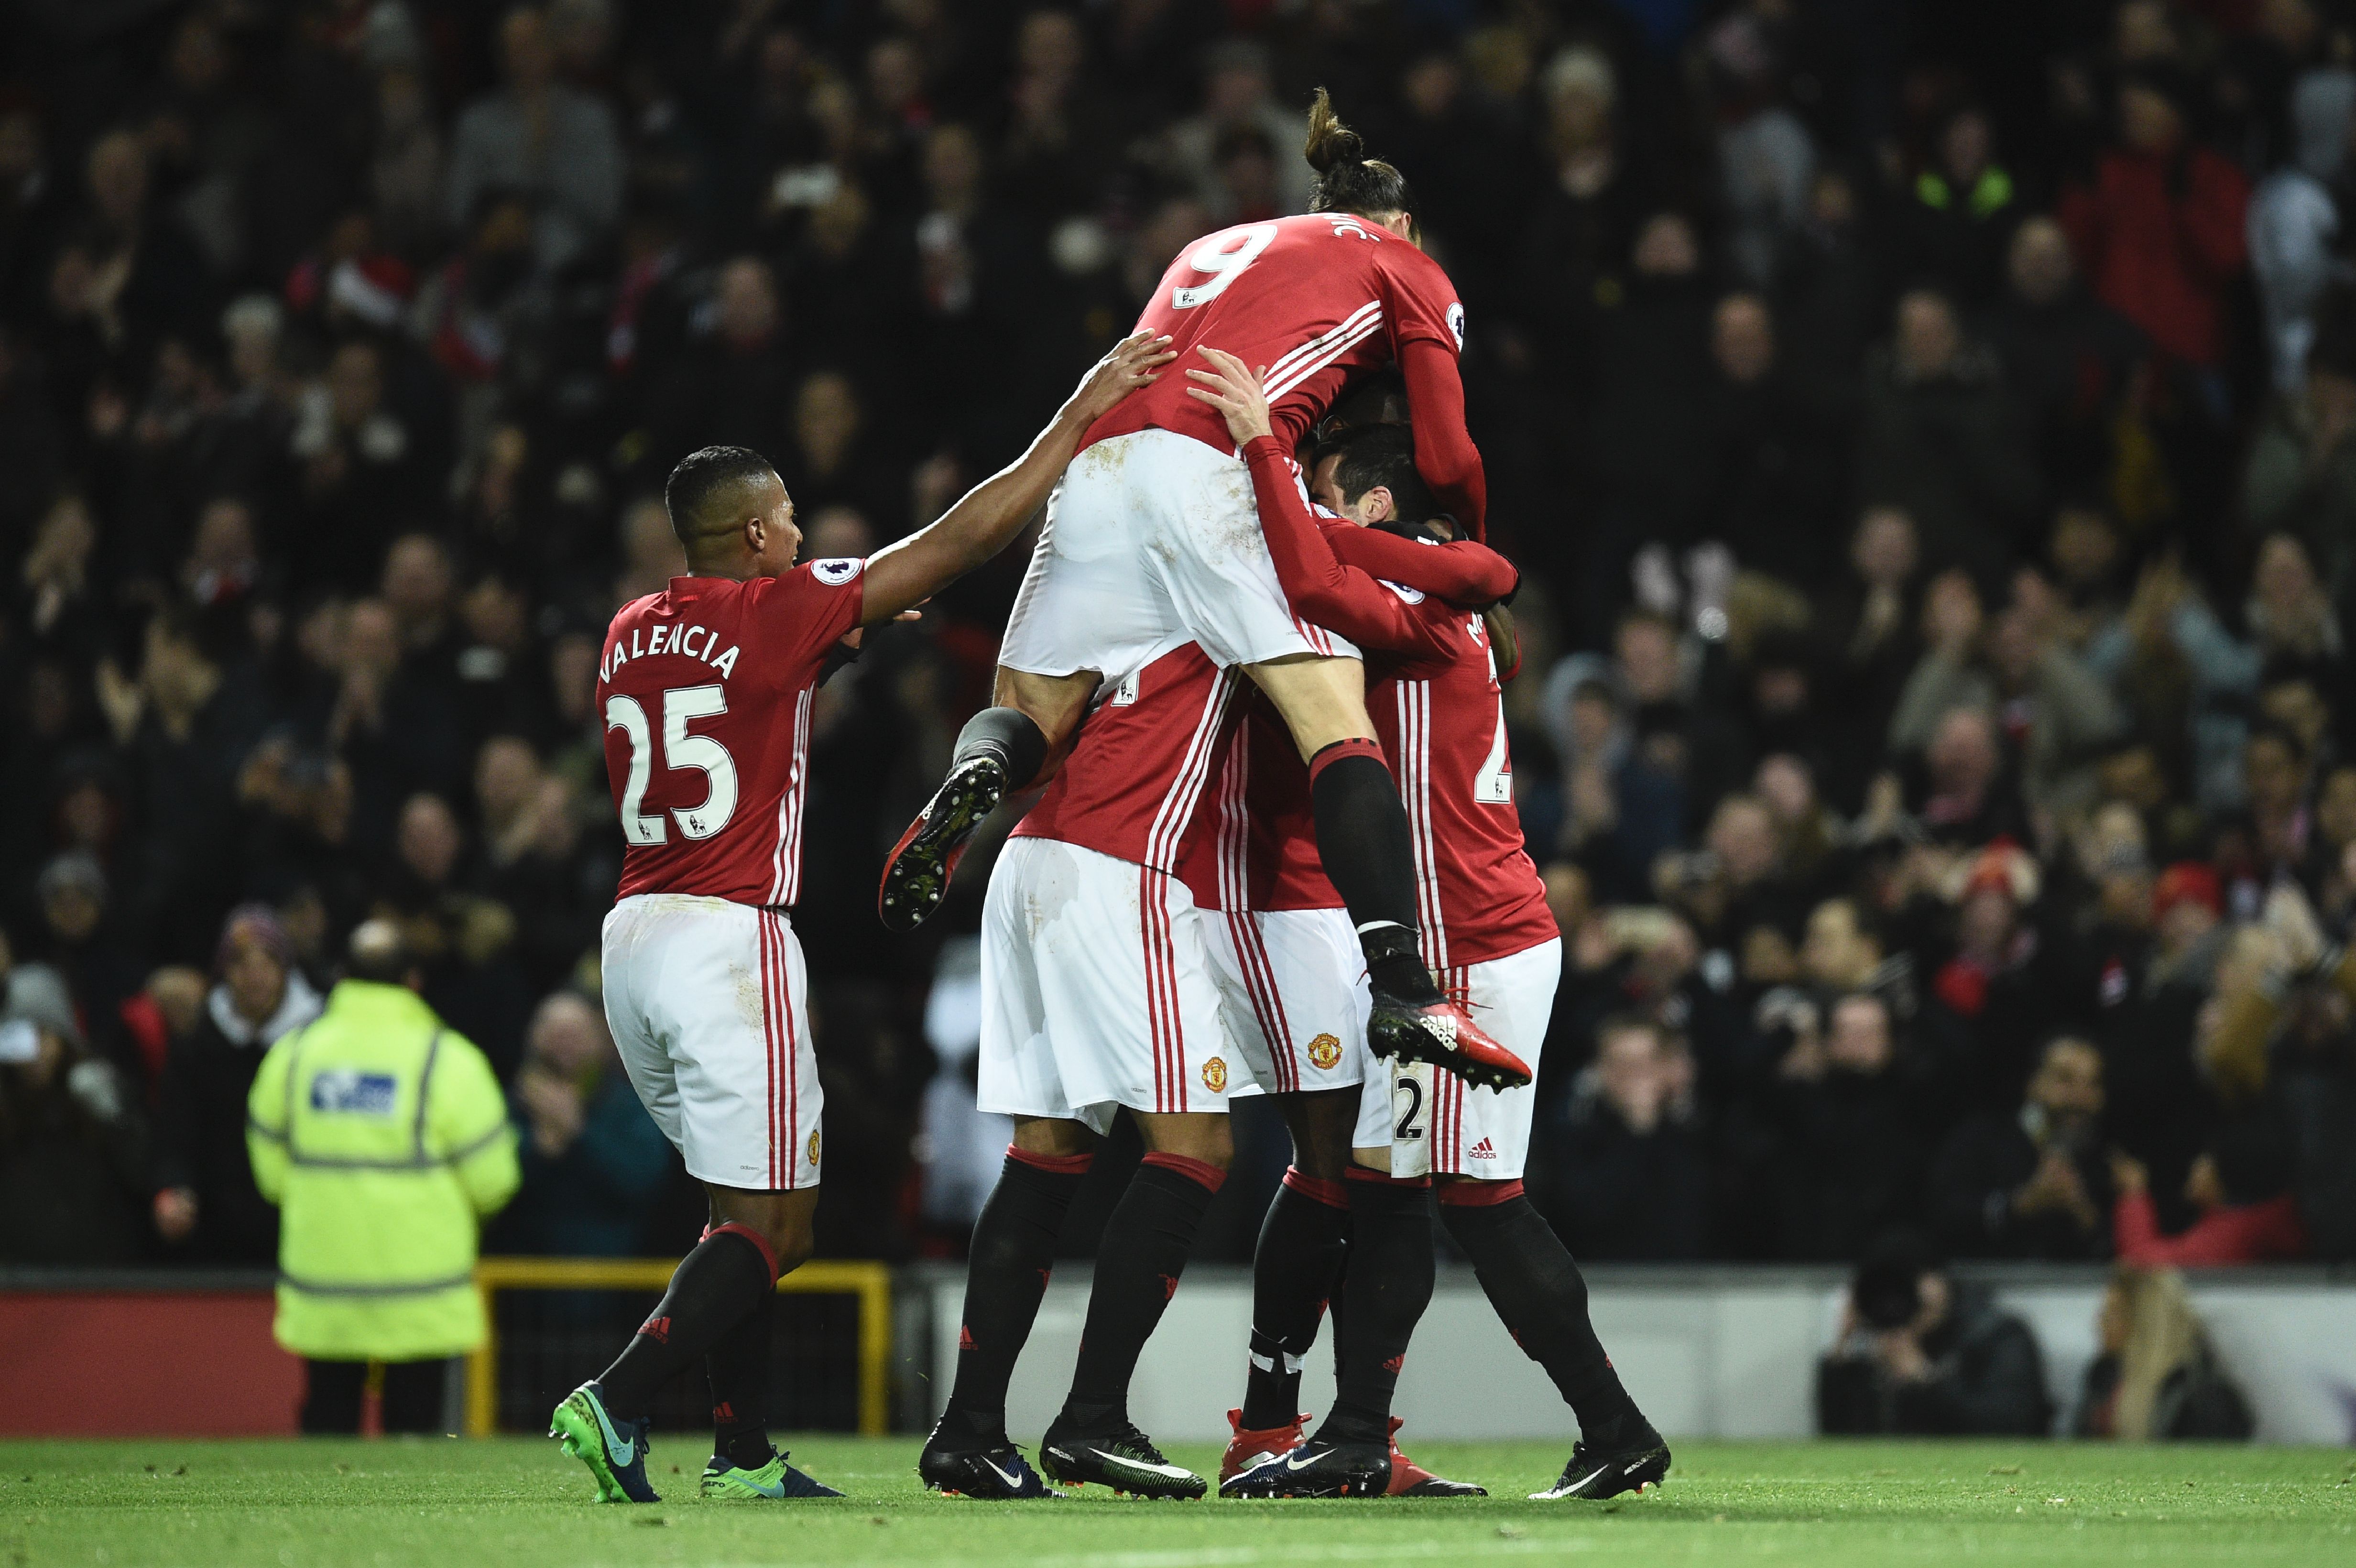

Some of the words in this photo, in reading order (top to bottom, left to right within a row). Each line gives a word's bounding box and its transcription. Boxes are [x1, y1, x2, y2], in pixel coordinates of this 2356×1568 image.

[1173, 225, 1278, 309] 9
[600, 623, 740, 684] VALENCIA
[1474, 645, 1514, 805] 2
[606, 684, 739, 846] 25
[1419, 1017, 1458, 1051] adidas
[1394, 1076, 1425, 1140] 2
[1468, 1150, 1497, 1159] adidas
